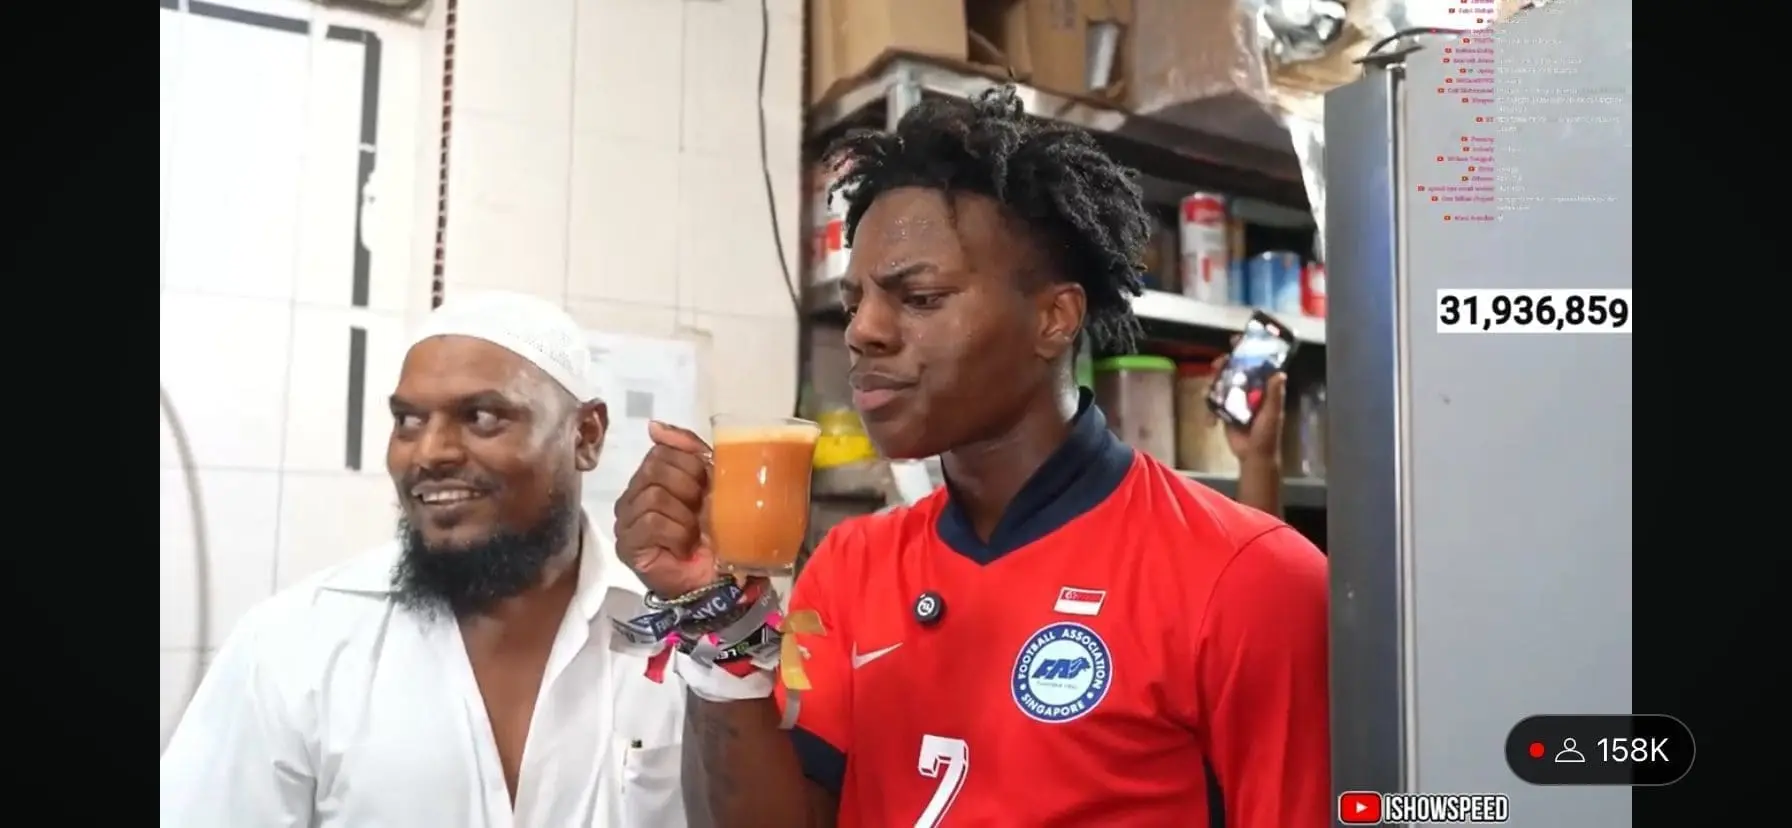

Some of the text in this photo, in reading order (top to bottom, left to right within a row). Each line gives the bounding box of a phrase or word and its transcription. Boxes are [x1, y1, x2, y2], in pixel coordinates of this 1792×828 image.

[1017, 628, 1106, 690] FOOTBALL ASSOCIATION
[1020, 693, 1086, 717] SINGAPORE
